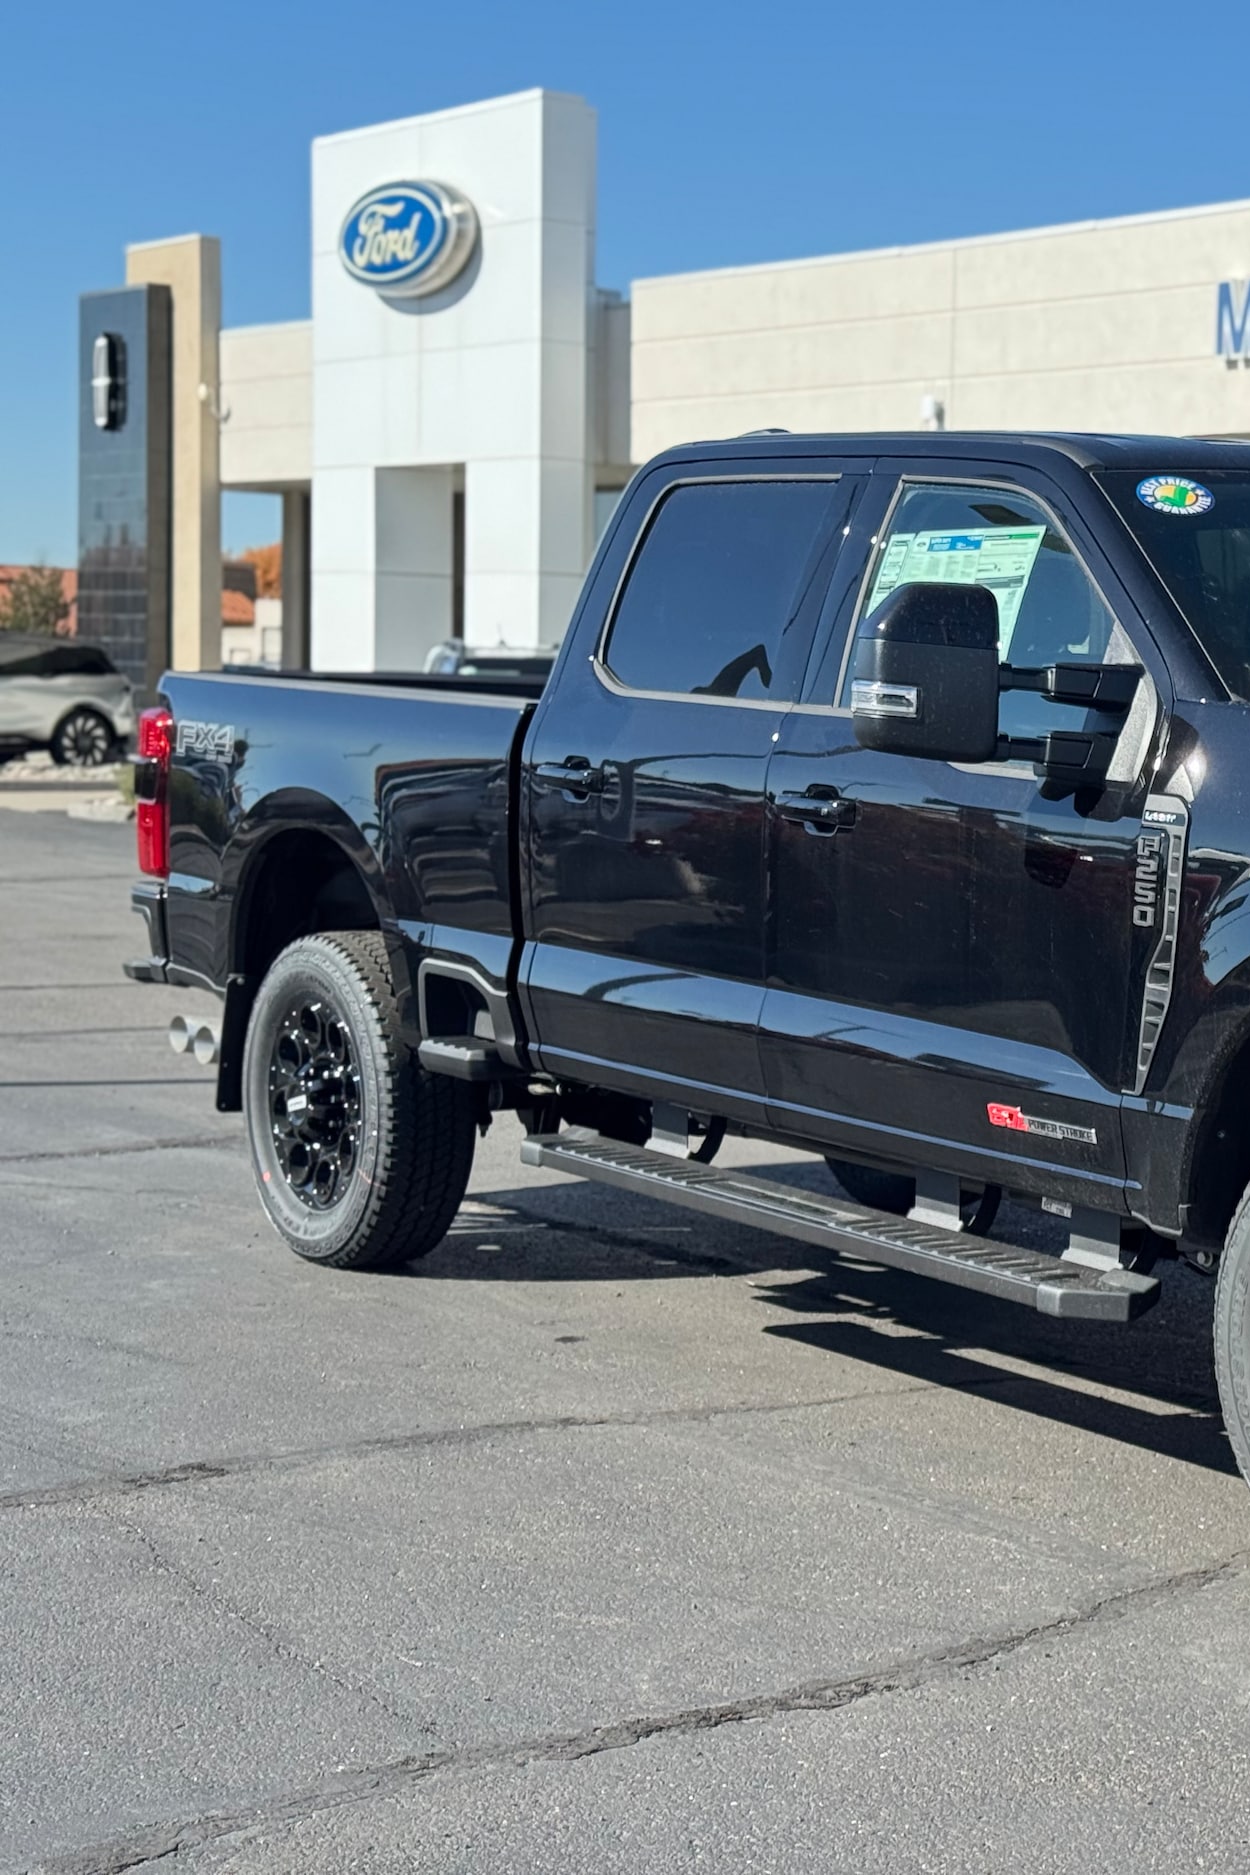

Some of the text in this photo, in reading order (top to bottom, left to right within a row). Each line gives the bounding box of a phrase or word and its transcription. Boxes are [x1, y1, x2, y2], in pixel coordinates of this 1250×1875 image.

[353, 201, 422, 267] Ford
[1158, 477, 1197, 491] PRICE
[176, 720, 235, 757] FX4
[1028, 1118, 1058, 1135] POWER
